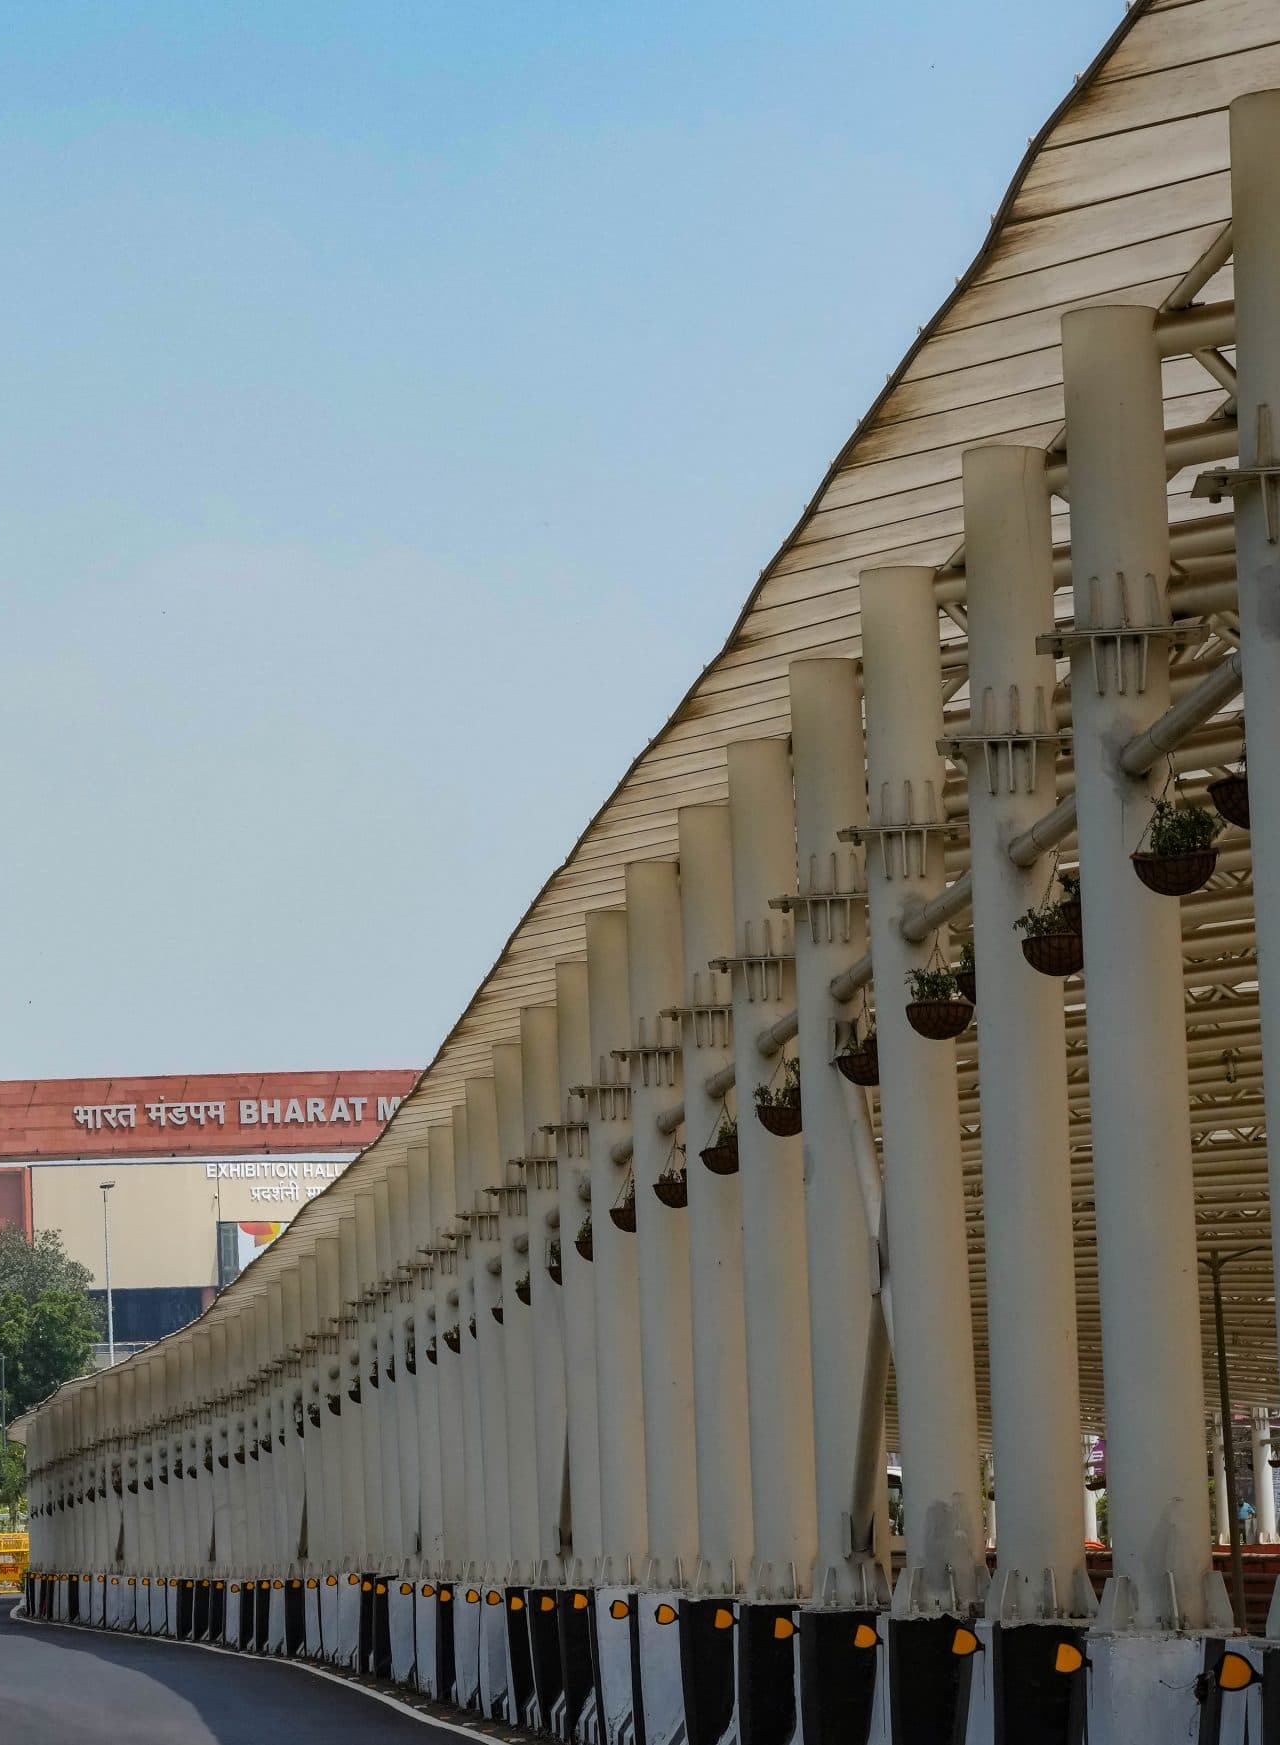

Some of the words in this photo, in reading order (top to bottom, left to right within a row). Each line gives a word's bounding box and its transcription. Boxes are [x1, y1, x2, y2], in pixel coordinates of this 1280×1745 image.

[73, 1103, 136, 1129] भारत
[145, 1095, 225, 1126] मंडपम
[239, 1097, 368, 1125] BHARAT
[206, 1162, 298, 1178] EXHIBITION
